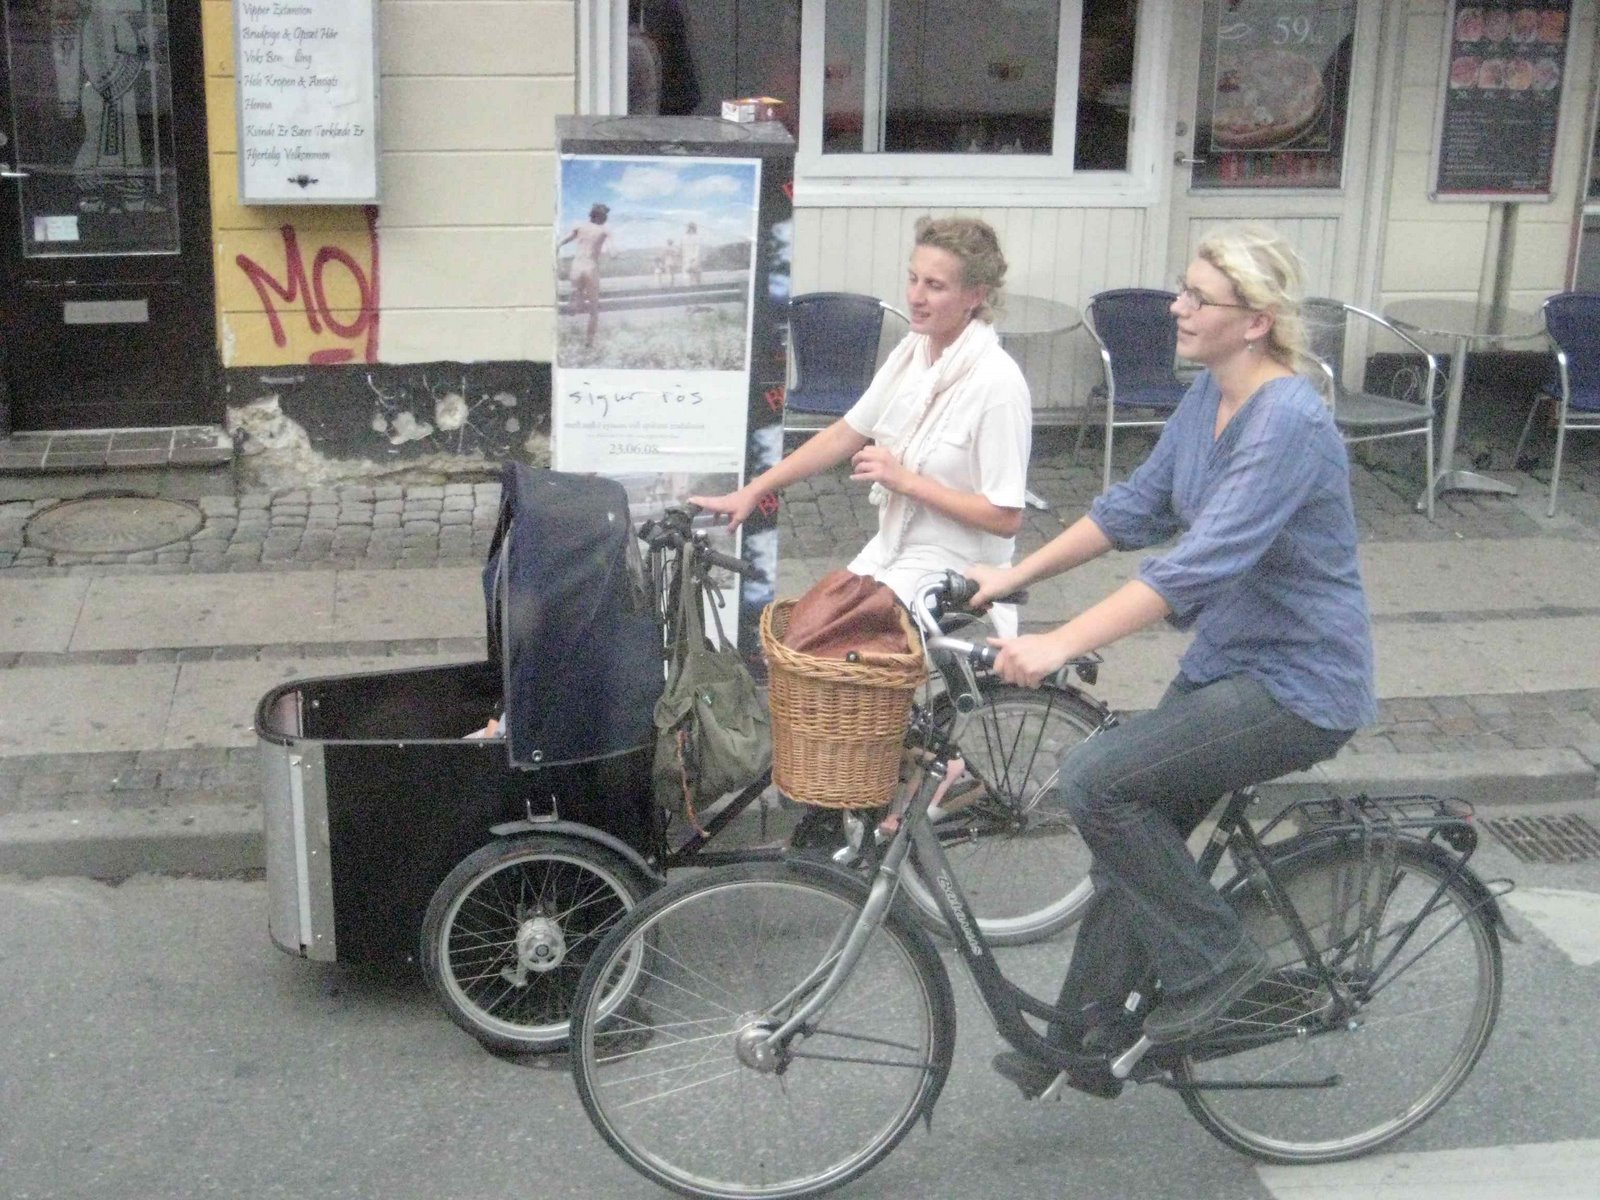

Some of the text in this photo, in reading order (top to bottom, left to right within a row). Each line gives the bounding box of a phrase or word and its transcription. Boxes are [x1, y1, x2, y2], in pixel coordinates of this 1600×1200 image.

[243, 3, 270, 22] Vipper
[282, 28, 292, 41] &
[297, 76, 306, 88] &
[569, 382, 641, 417] sigur
